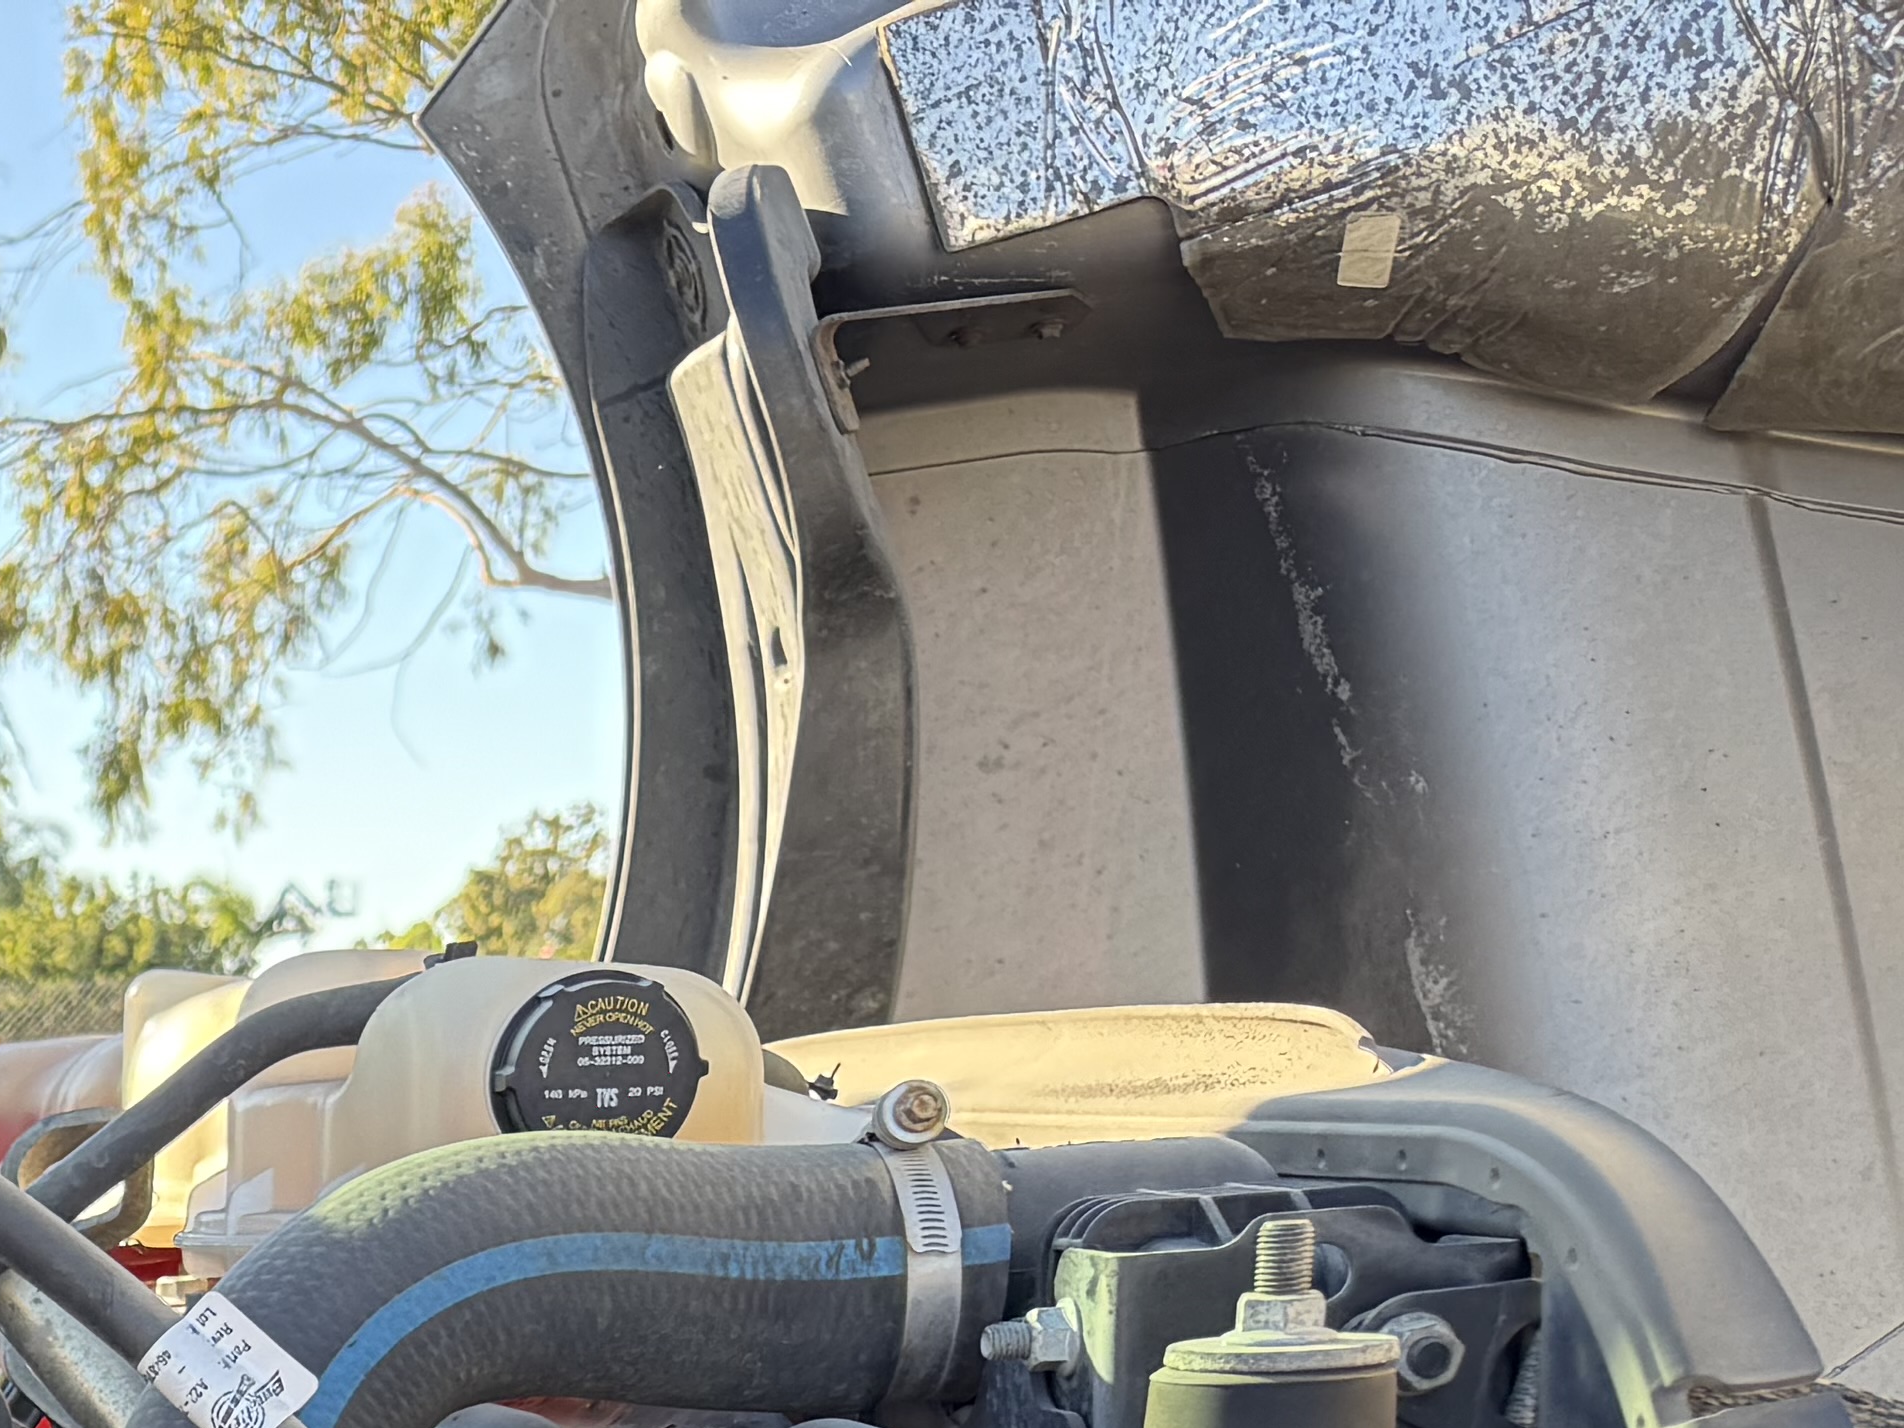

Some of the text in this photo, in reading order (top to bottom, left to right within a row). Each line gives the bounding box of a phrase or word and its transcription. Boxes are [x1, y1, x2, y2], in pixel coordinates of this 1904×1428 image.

[588, 996, 649, 1015] CAUTION
[570, 1012, 655, 1037] NEVER OPEN HOT
[578, 1034, 645, 1045] PRESSURIZED
[591, 1046, 631, 1055] SYSTEM
[596, 1088, 619, 1108] TVS
